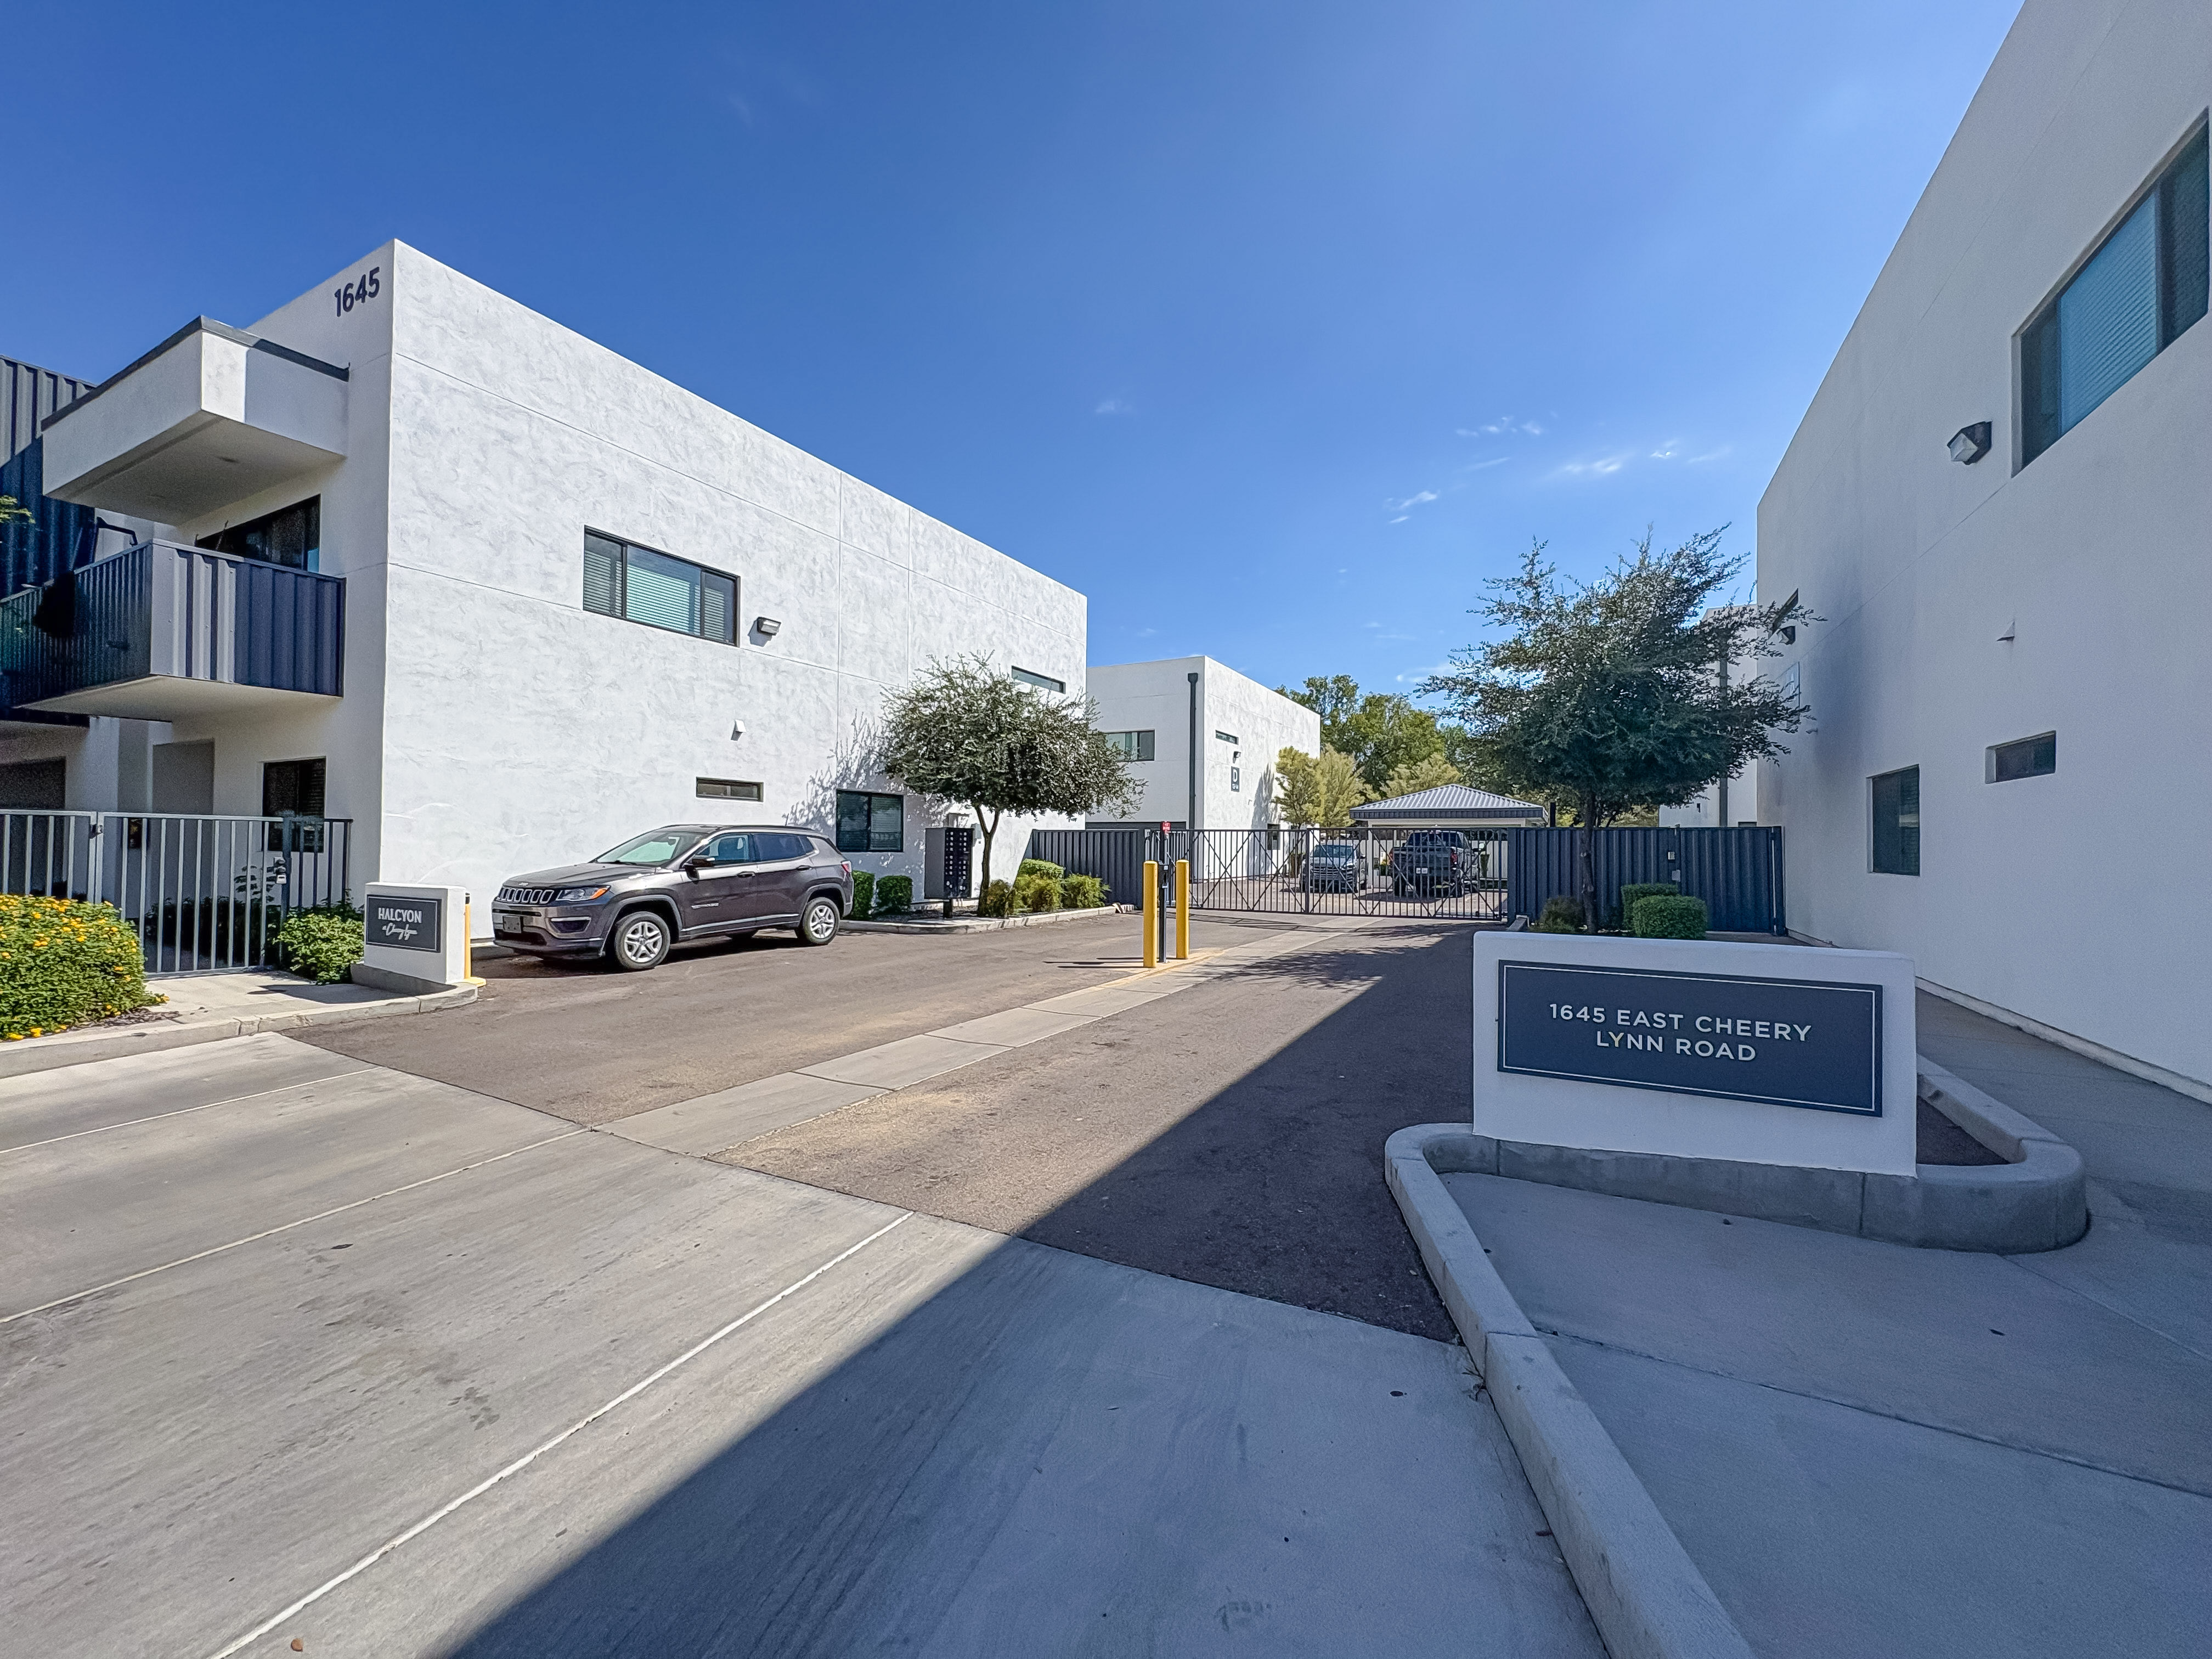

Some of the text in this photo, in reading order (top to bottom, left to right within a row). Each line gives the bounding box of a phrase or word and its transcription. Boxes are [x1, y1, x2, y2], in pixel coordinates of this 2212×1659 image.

[334, 267, 380, 317] 1645
[1233, 769, 1238, 782] D
[378, 907, 422, 924] HALCYON
[1550, 1003, 1812, 1041] 1645 EAST CHEERY
[1597, 1031, 1756, 1062] LYNN ROAD
